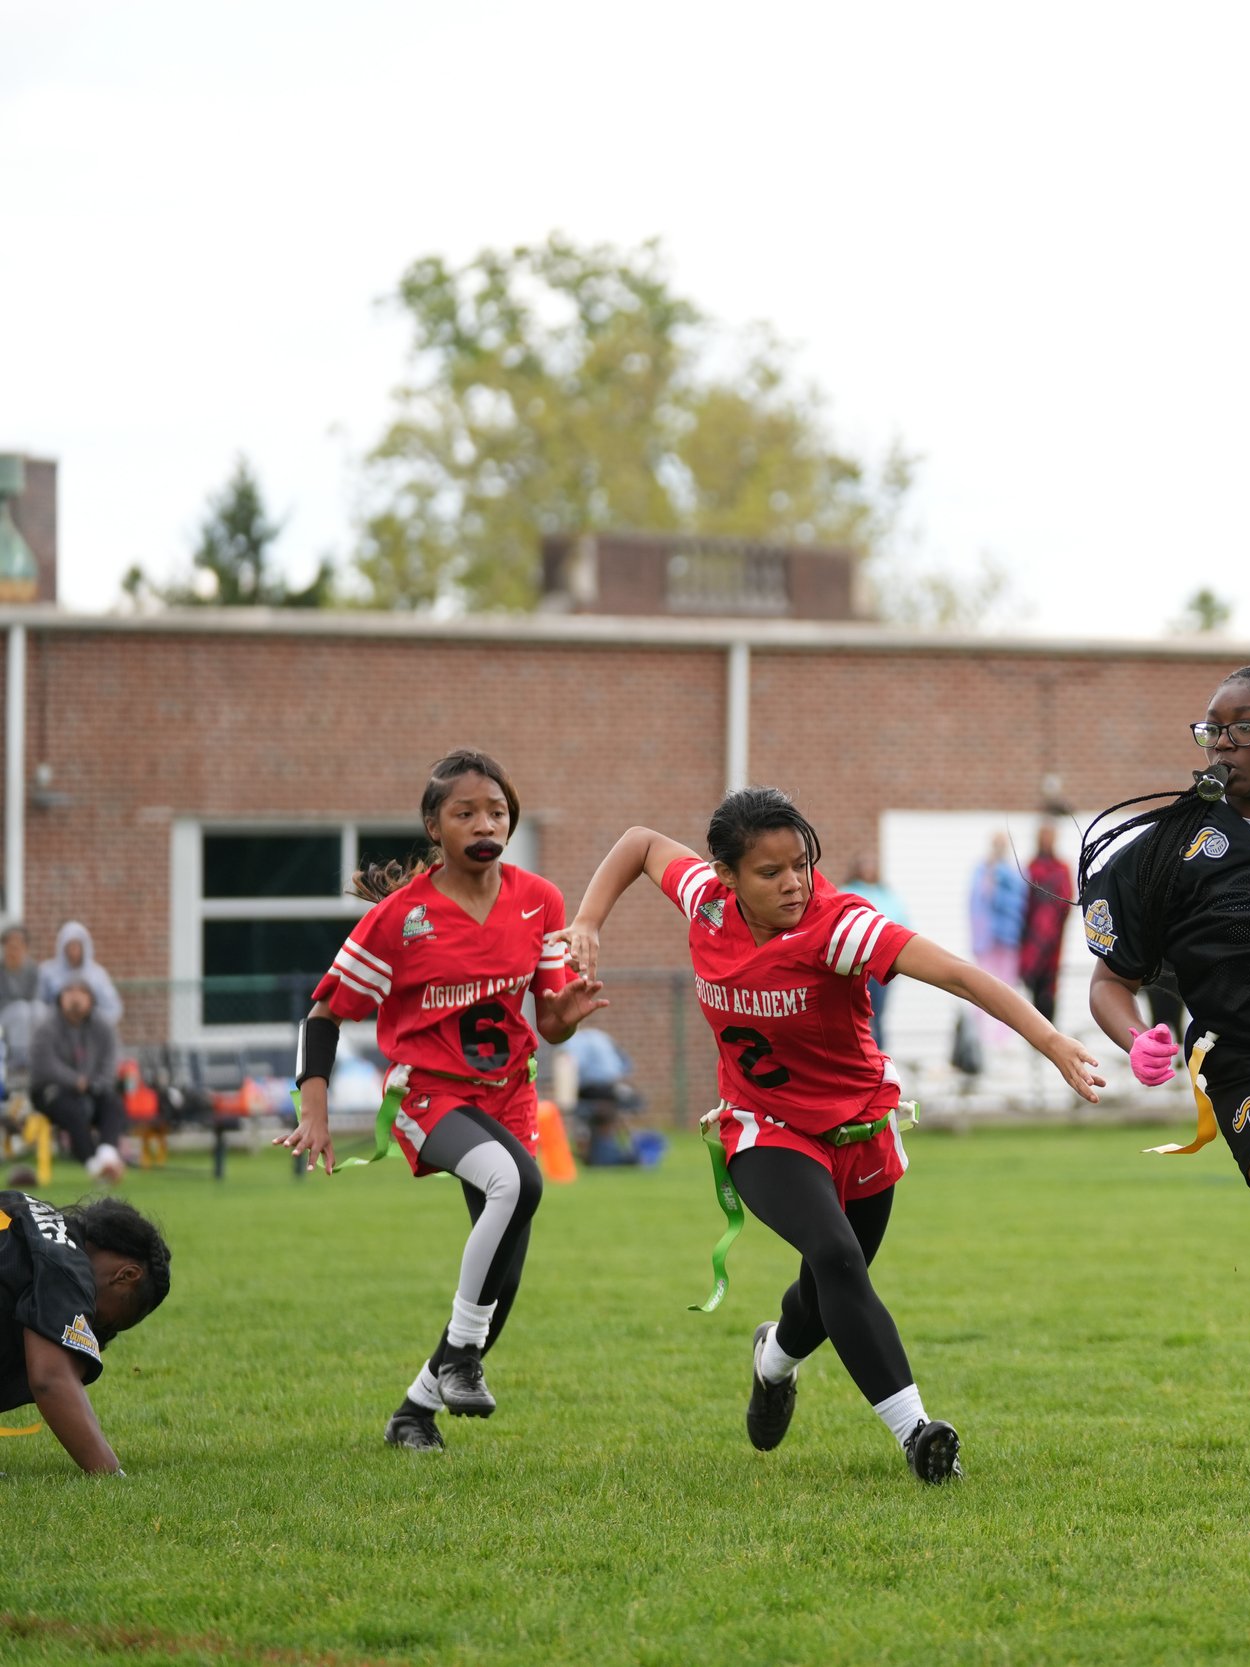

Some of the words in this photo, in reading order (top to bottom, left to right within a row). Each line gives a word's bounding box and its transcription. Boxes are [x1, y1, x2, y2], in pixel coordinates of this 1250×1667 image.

[733, 986, 808, 1018] ACADEMY
[459, 1001, 511, 1072] 6
[720, 1025, 791, 1089] 2
